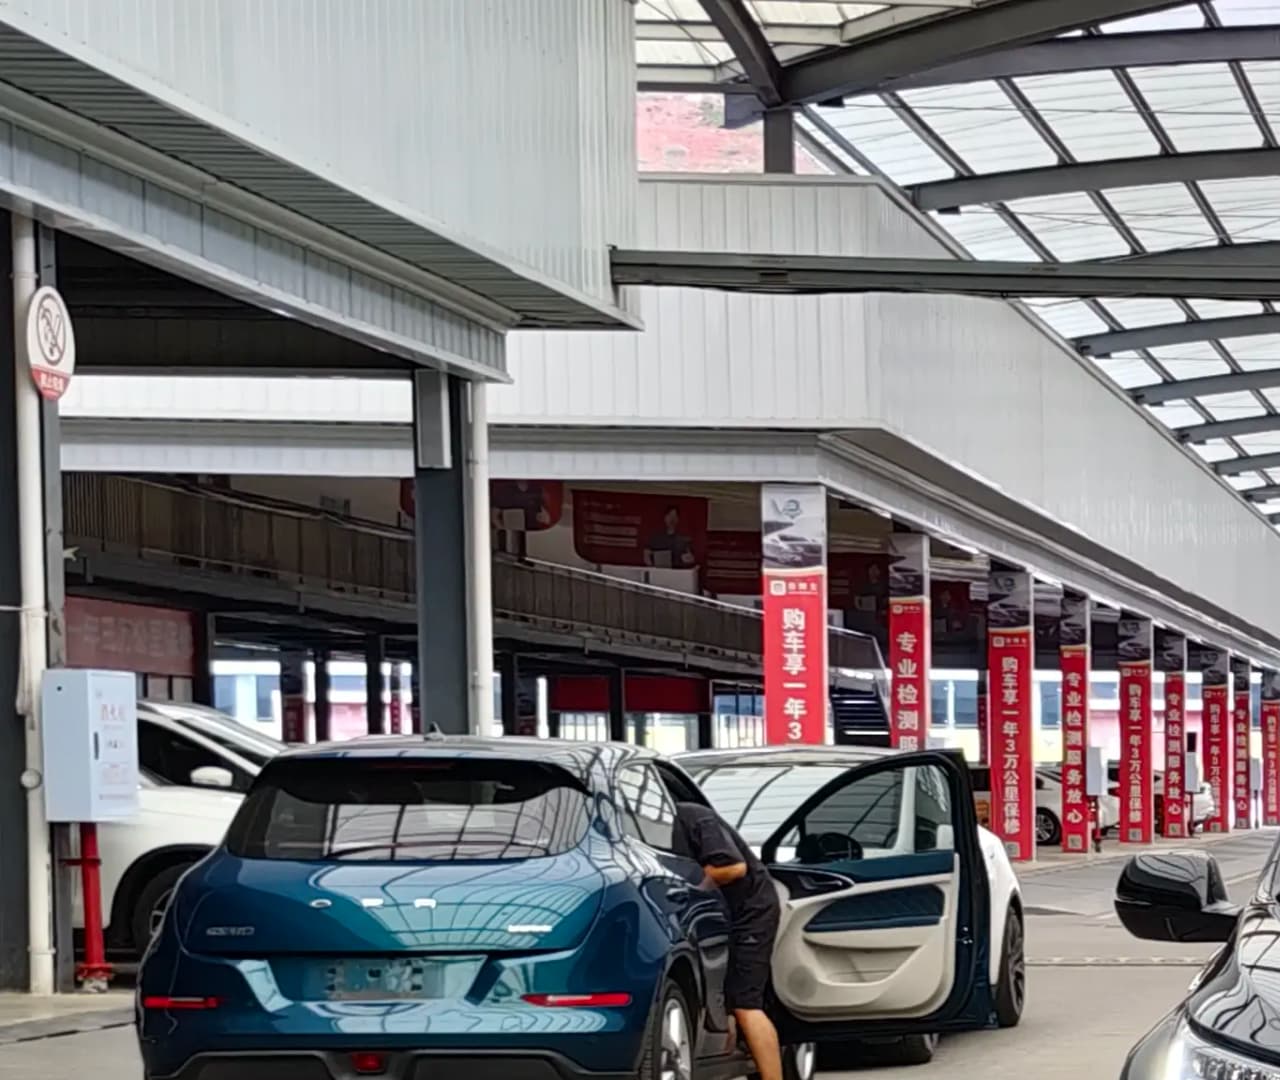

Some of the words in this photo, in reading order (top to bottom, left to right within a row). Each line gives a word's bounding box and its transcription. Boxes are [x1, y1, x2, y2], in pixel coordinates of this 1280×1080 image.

[1001, 656, 1021, 834] 购车享一年3万公里保修
